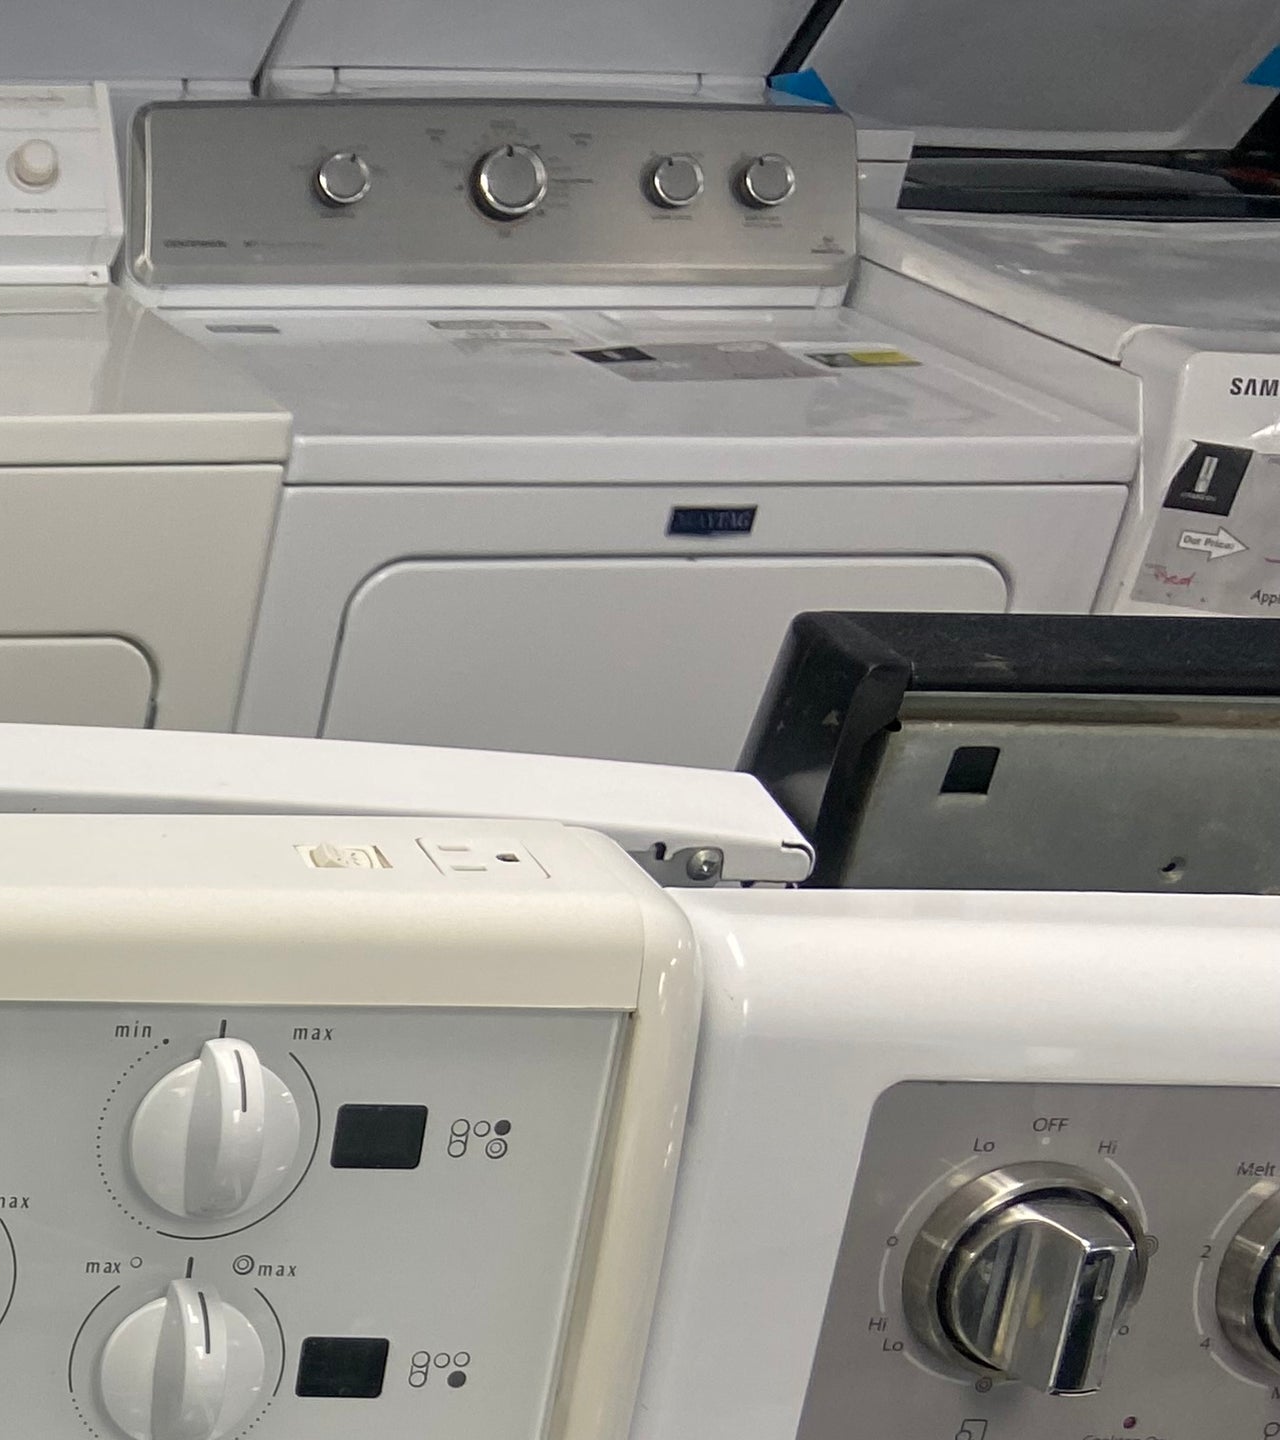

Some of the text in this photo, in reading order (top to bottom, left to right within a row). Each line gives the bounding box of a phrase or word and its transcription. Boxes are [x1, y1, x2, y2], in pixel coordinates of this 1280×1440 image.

[114, 1020, 152, 1038] min
[292, 1027, 333, 1041] max
[1032, 1117, 1070, 1133] OFF
[972, 1137, 996, 1153] Lo
[1097, 1140, 1118, 1155] Hi
[1236, 1161, 1276, 1177] Melt
[1199, 1244, 1212, 1259] 2
[85, 1261, 122, 1274] max
[257, 1264, 297, 1277] max
[868, 1317, 887, 1332] Hi
[882, 1337, 905, 1352] Lo
[1199, 1336, 1211, 1351] 4
